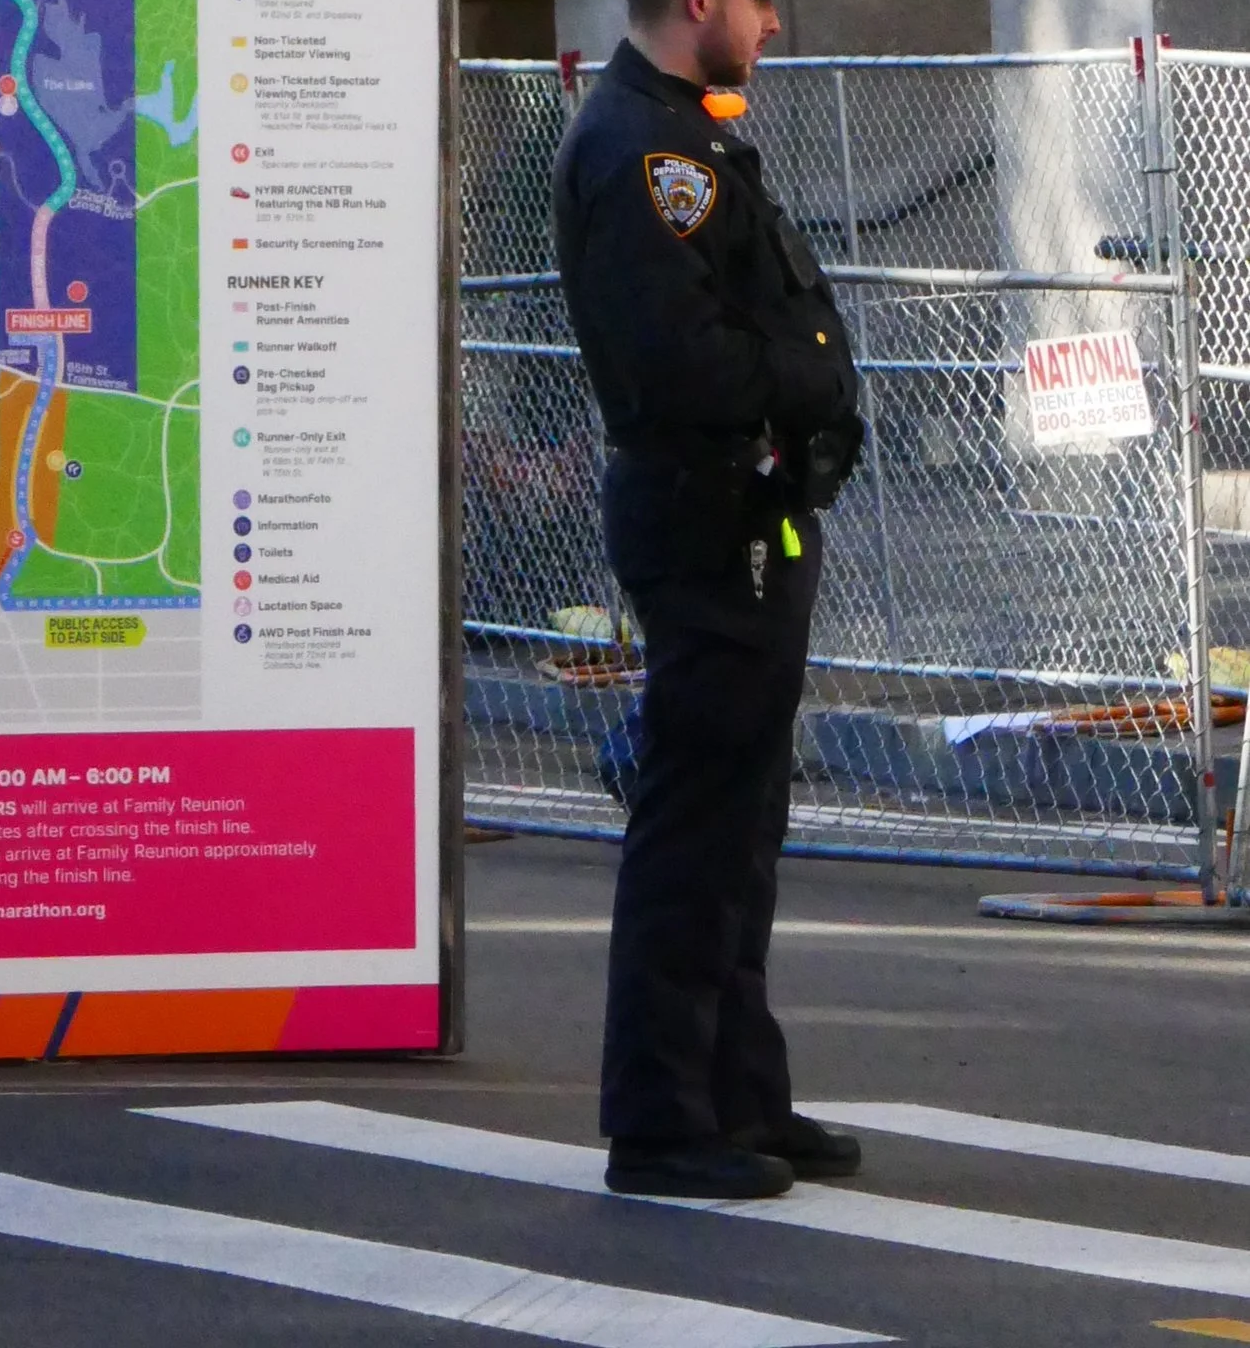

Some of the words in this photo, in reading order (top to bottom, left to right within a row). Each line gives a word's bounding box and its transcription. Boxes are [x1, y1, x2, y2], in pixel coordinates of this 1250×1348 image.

[254, 36, 326, 46] Non-Ticketed
[255, 50, 305, 60] Spectator
[309, 50, 350, 61] Viewing
[255, 76, 326, 85] Non-Ticketed
[329, 76, 380, 87] Spectator
[255, 90, 297, 100] Viewing
[300, 90, 345, 98] Entrance
[255, 148, 274, 157] Exit
[255, 199, 303, 210] featuring
[306, 200, 322, 208] the
[325, 199, 340, 208] NB
[342, 199, 363, 208] Run
[365, 200, 386, 208] Hub
[255, 239, 298, 249] Security
[302, 239, 354, 250] Screening
[357, 239, 383, 248] Zone
[227, 276, 290, 289] RUNNER
[294, 276, 324, 289] KEY
[257, 302, 315, 311] Post-Finish
[12, 314, 53, 327] FINISH
[57, 314, 85, 328] LINE
[257, 316, 294, 325] Runner
[297, 316, 349, 325] Amenities
[257, 342, 294, 351] Runner
[298, 342, 337, 351] Walkoff
[1028, 334, 1139, 392] NATIONAL
[257, 369, 325, 378] Pre-Checked
[257, 383, 277, 393] Bag
[280, 383, 315, 393] Pickup
[1037, 404, 1147, 432] 800-352-5675
[257, 432, 323, 443] Runner-Only
[326, 432, 345, 441] Exit
[258, 494, 331, 503] MarathonFoto
[258, 521, 318, 530] Information
[259, 548, 293, 557] Toilets
[259, 575, 299, 584] Medical
[302, 575, 319, 583] Aid
[259, 602, 307, 611] Lactation
[310, 602, 342, 612] Space
[50, 618, 89, 631] PUBLIC
[93, 617, 139, 629] ACCESS
[50, 631, 66, 644] TO
[69, 631, 99, 643] EAST
[101, 630, 126, 643] SIDE
[259, 628, 284, 637] AWD
[287, 628, 310, 637] Post
[313, 628, 344, 636] Finish
[347, 628, 371, 636] Area
[86, 767, 133, 784] 6:00
[138, 766, 170, 783] PM
[22, 801, 46, 814] will
[52, 799, 98, 815] arrive
[103, 799, 118, 814] at
[124, 798, 175, 815] Family
[181, 797, 245, 812] Reunion
[27, 824, 64, 838] after
[70, 821, 139, 839] crossing
[145, 821, 170, 836] the
[175, 820, 217, 835] finish
[223, 819, 255, 835] line.
[5, 846, 51, 862] arrive
[56, 845, 71, 860] at
[77, 845, 128, 862] Family
[135, 843, 199, 859] Reunion
[204, 841, 316, 860] approximately
[24, 869, 50, 884] the
[55, 868, 98, 883] finish
[103, 867, 135, 882] line.
